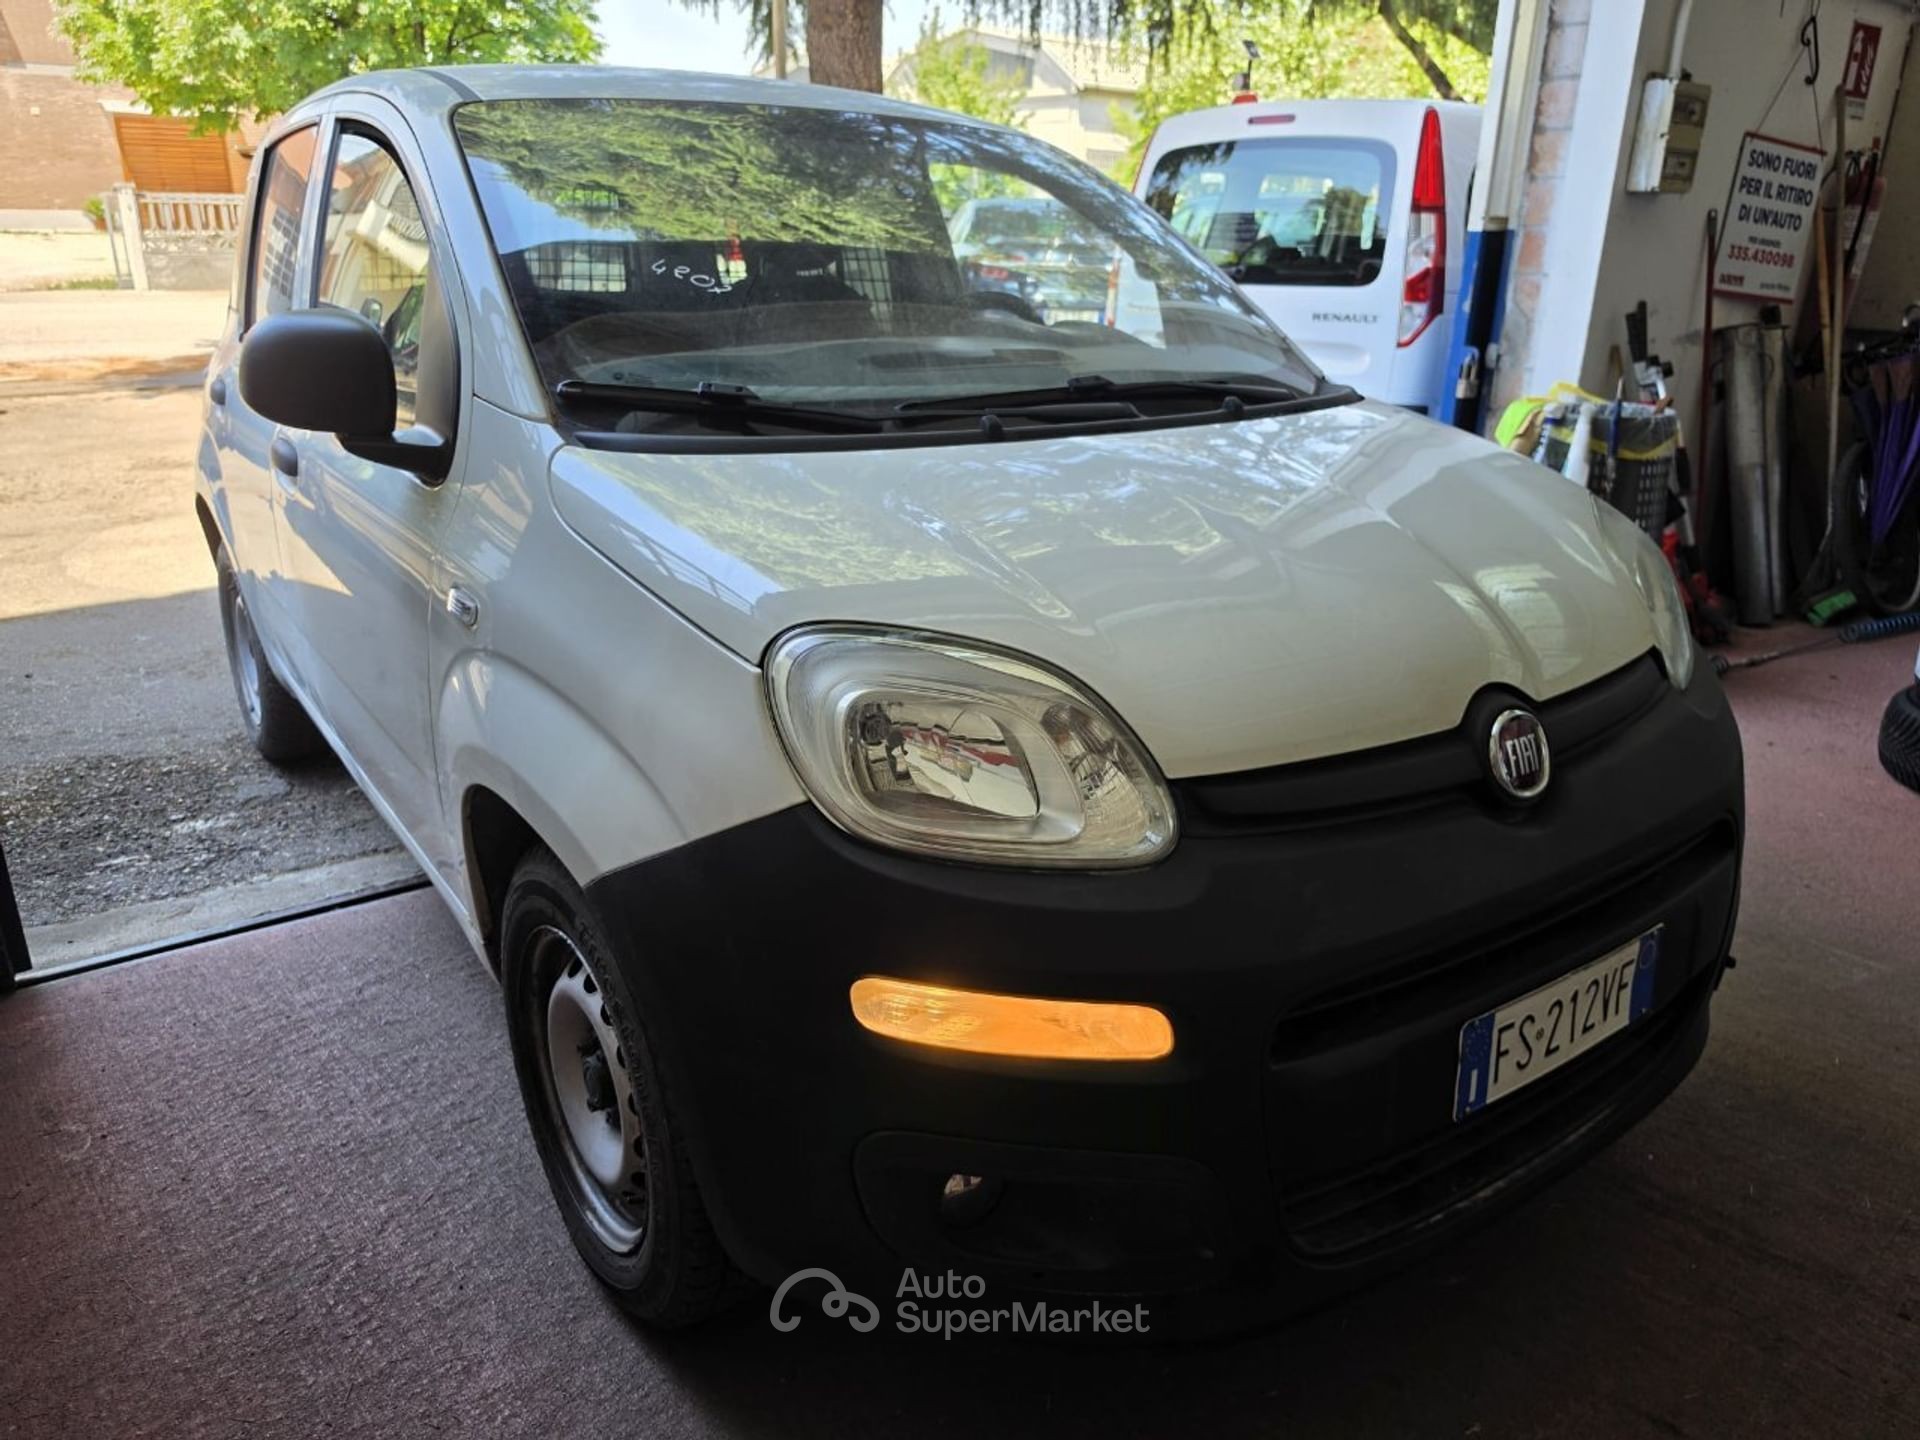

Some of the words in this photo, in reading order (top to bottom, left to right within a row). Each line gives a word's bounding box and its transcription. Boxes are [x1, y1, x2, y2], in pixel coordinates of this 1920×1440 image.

[1748, 149, 1781, 174] SONO
[1782, 156, 1817, 180] FUORI
[1739, 176, 1762, 196] PER
[1763, 181, 1774, 199] IL
[1775, 184, 1814, 207] RITIRO
[1738, 204, 1751, 223] DI
[1753, 207, 1803, 232] UN'AUTO
[1311, 312, 1379, 324] RENAULT
[1505, 733, 1540, 778] FIAT
